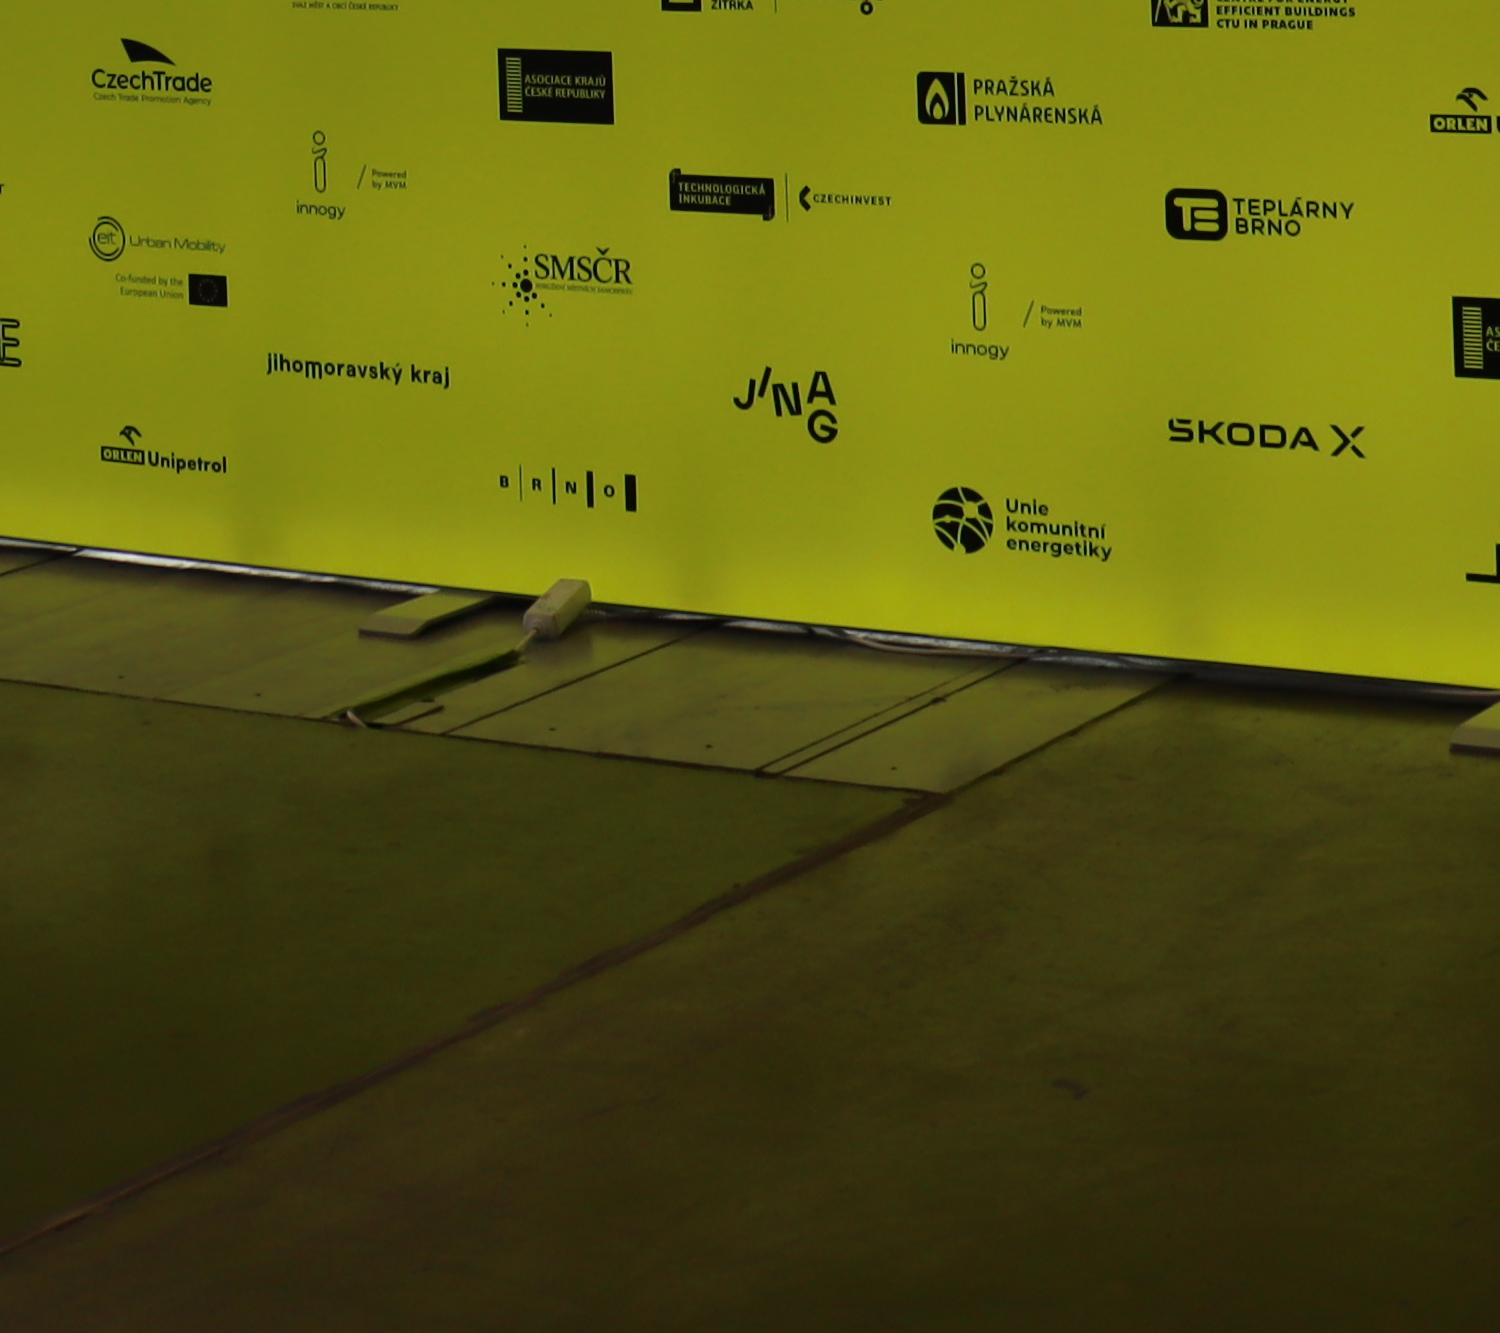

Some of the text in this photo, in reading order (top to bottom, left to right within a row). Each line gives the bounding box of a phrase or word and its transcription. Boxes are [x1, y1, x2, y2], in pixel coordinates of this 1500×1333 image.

[1216, 5, 1355, 17] EFFICIENT BUILDINGS
[1216, 18, 1312, 30] CTU IN PRAGUE
[91, 68, 212, 92] CzechTrade
[973, 76, 1054, 96] PRAŽSKÁ
[974, 103, 1102, 124] PLYNÁRENSKÁ
[1434, 117, 1487, 131] ORLEN
[296, 200, 345, 220] innogy
[813, 194, 890, 206] CZECHINVEST
[1232, 197, 1354, 219] TEPLÁRNY
[1235, 217, 1300, 236] BRNO
[534, 247, 632, 284] SMSČR
[951, 339, 1009, 360] innogy
[267, 352, 449, 389] jihomoravský kraj
[1330, 424, 1365, 458] X
[103, 448, 142, 462] ORLEN
[148, 450, 226, 474] Unipetrol
[1006, 498, 1048, 516] Unie
[1006, 515, 1105, 539] komunitní
[1006, 538, 1112, 562] energetiky
